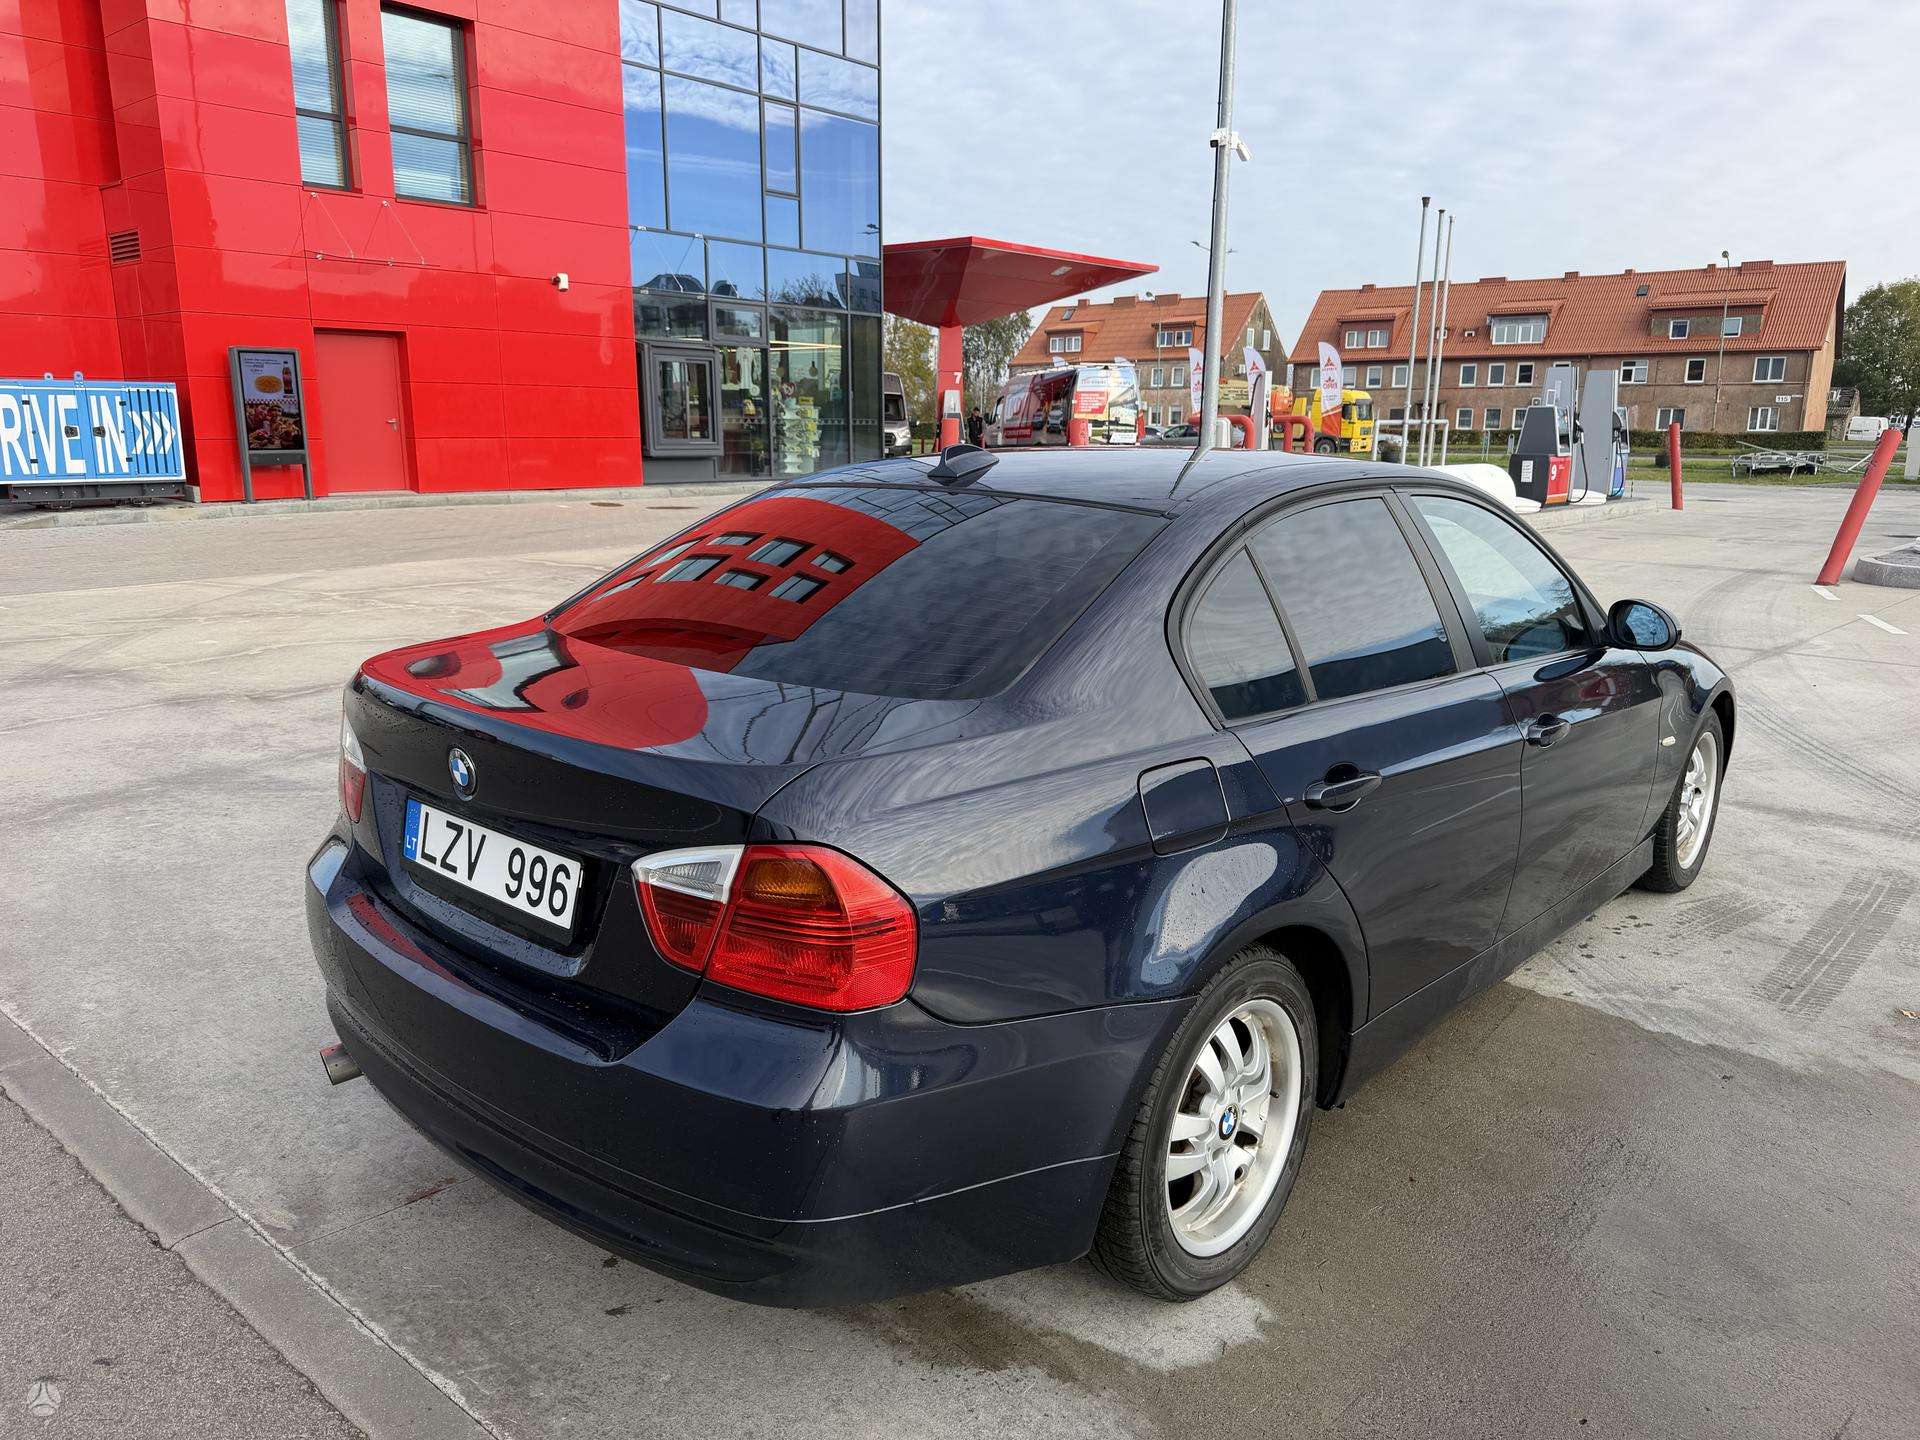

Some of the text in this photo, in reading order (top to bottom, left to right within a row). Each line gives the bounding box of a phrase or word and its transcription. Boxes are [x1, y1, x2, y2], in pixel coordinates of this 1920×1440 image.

[953, 371, 963, 385] 7
[0, 393, 130, 476] RIVE IN
[1550, 464, 1558, 481] 9
[406, 835, 417, 851] LT
[420, 811, 571, 918] LZV 996
